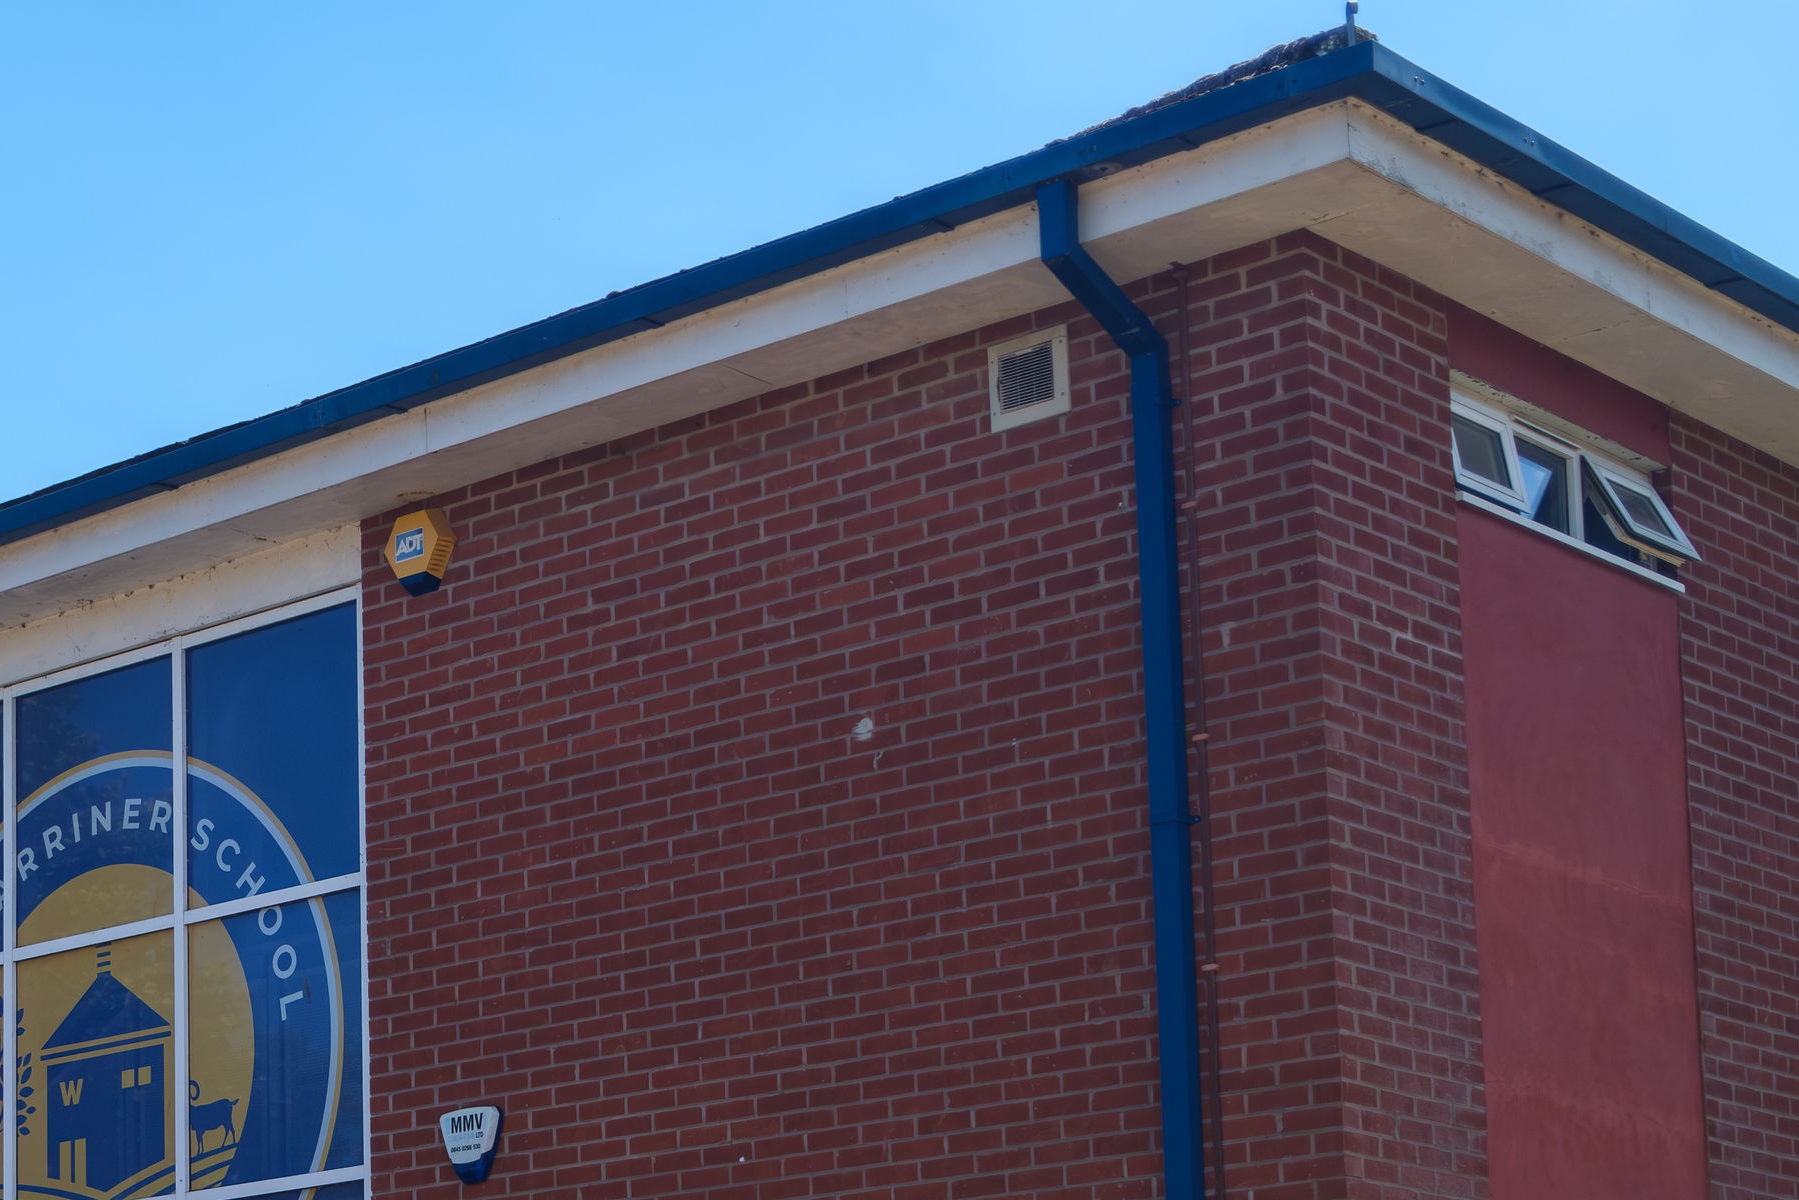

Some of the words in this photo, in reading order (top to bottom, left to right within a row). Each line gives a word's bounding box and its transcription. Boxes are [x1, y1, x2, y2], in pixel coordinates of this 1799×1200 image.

[396, 533, 423, 556] ADT
[190, 817, 304, 1022] SCHOOL
[59, 1078, 84, 1107] W
[451, 1112, 484, 1134] MMV
